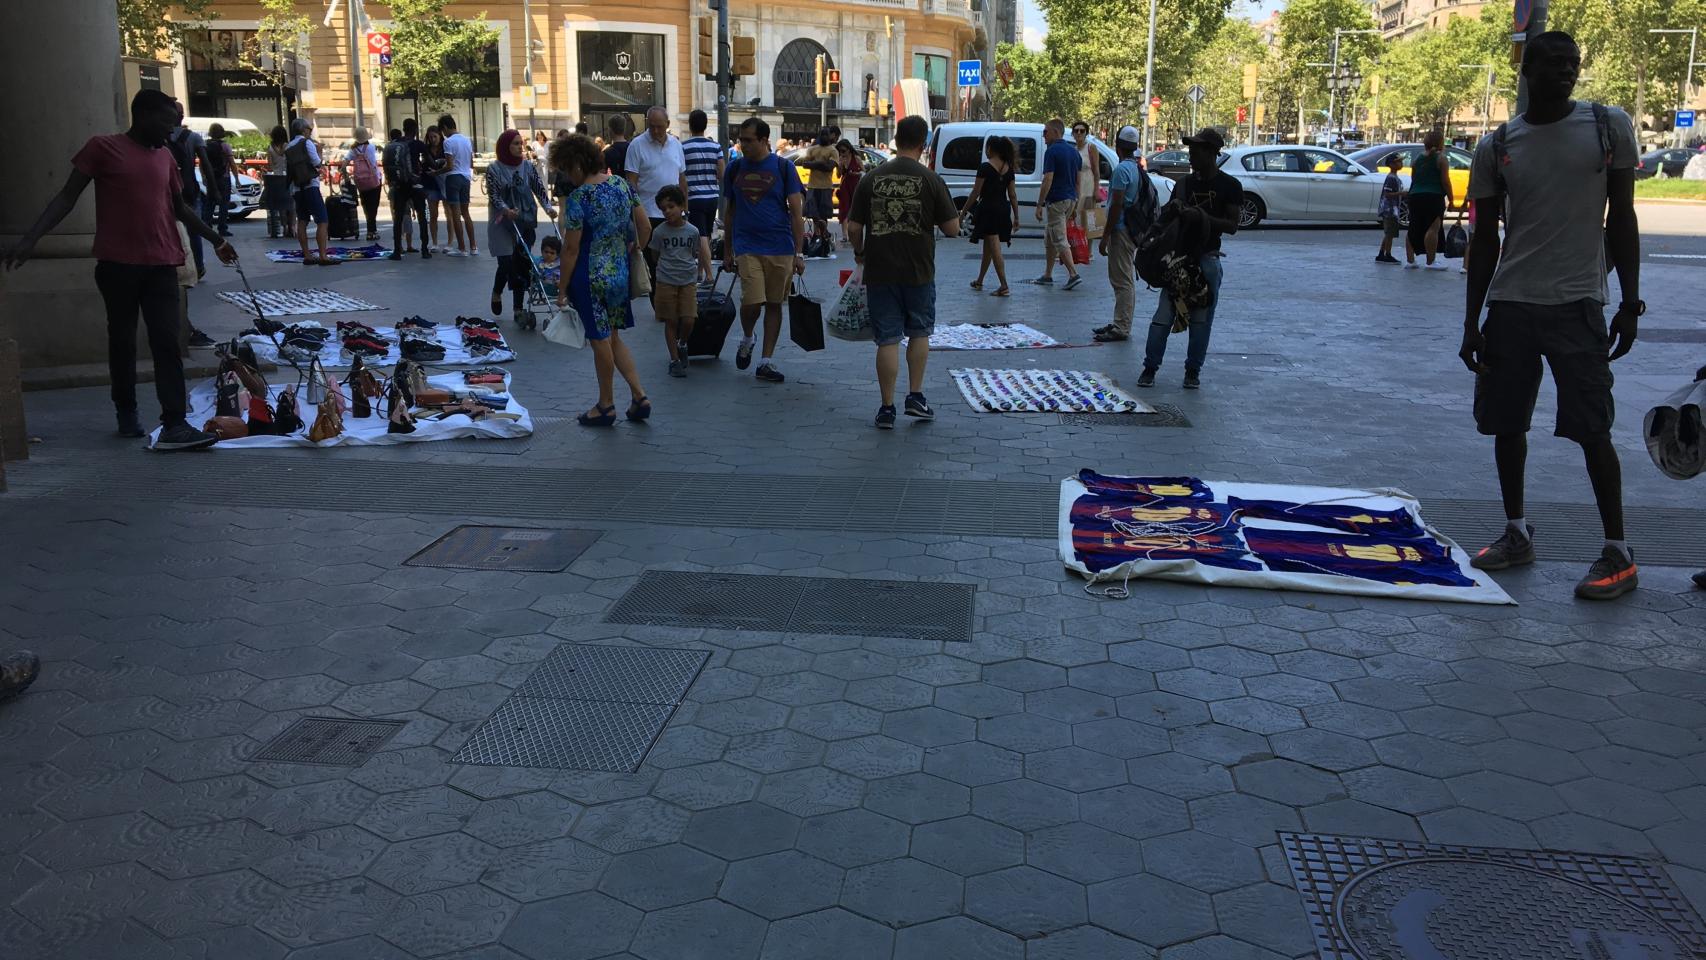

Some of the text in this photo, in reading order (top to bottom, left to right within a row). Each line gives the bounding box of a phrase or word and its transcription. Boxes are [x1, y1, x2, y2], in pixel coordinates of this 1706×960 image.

[592, 71, 655, 82] Massimo Dutti
[960, 69, 980, 78] TAXI
[222, 79, 268, 87] Massimo Dutti
[664, 236, 694, 249] POLO
